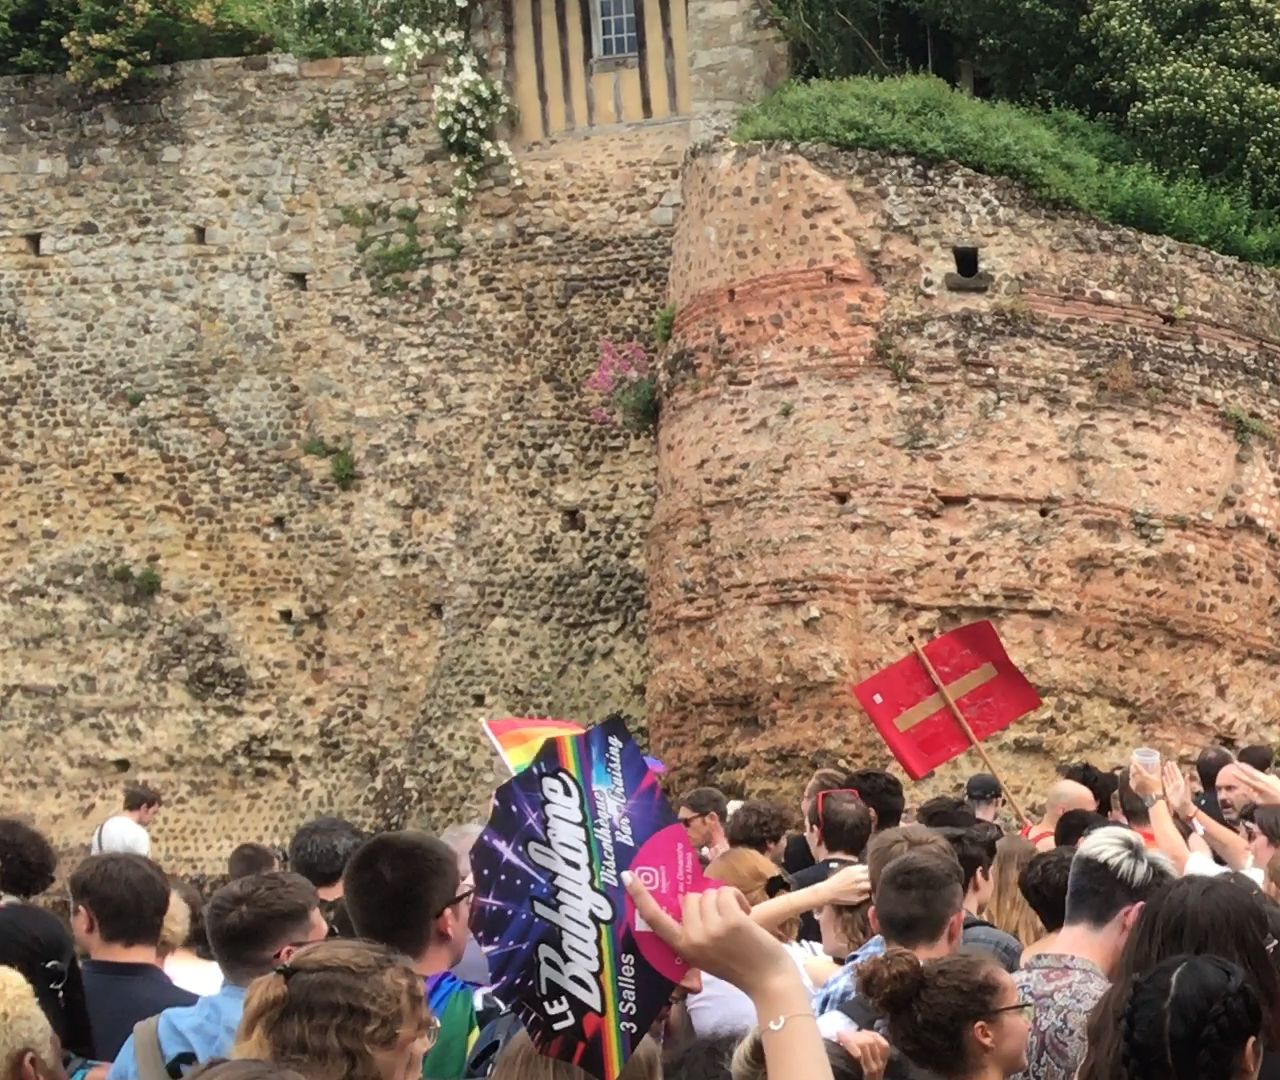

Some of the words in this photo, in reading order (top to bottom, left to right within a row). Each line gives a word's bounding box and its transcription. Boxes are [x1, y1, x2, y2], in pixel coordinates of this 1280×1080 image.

[606, 734, 627, 802] Cruising
[592, 789, 619, 888] Discothèque
[614, 815, 635, 847] Bar
[527, 770, 614, 1014] Babylone
[542, 995, 576, 1032] LE
[617, 952, 637, 1017] Salles
[619, 1020, 638, 1034] 3
